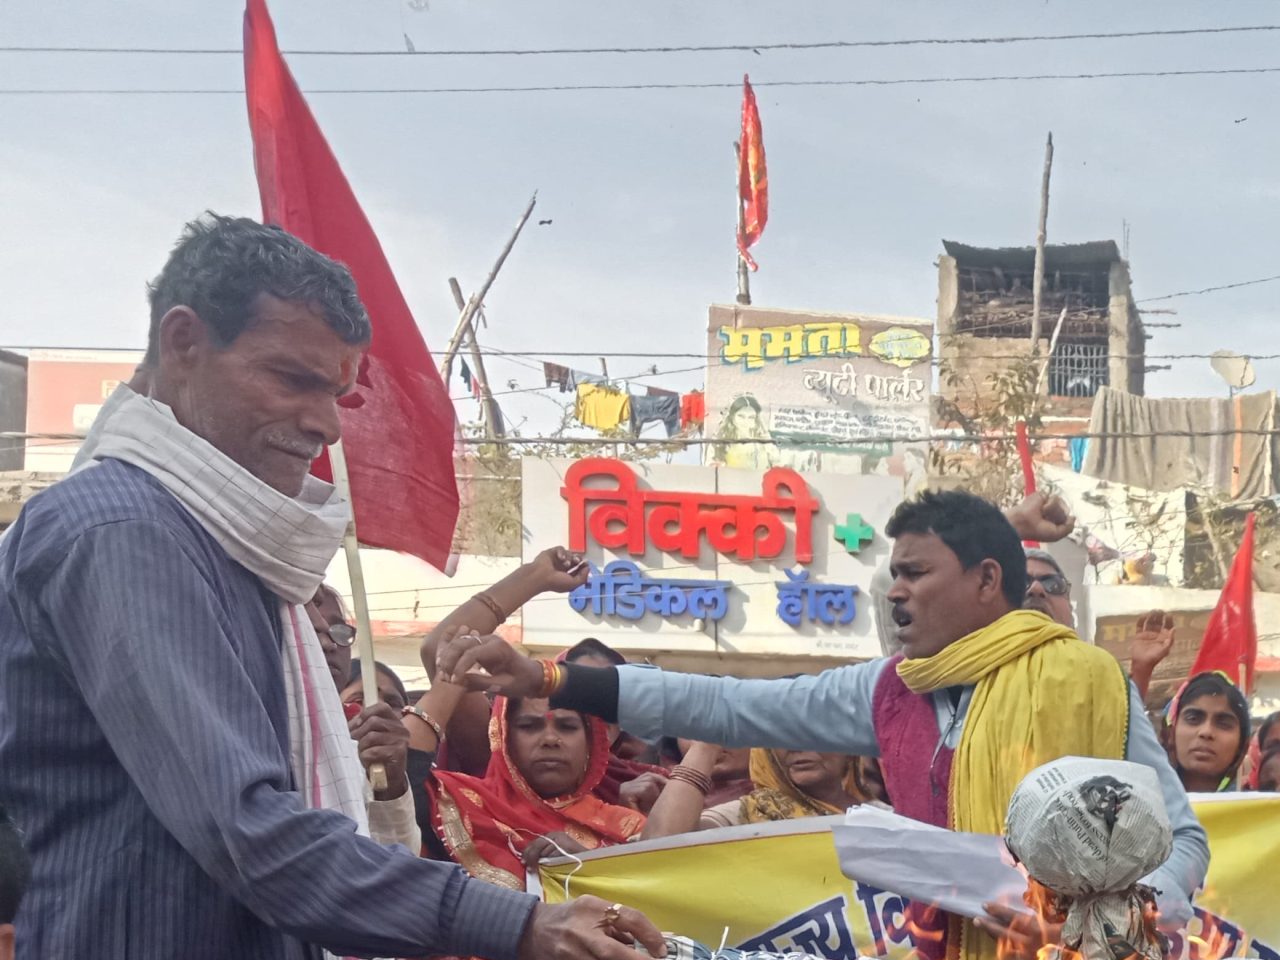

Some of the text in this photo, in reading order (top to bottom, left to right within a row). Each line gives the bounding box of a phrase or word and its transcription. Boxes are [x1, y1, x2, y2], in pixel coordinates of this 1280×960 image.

[719, 322, 862, 371] ममता
[560, 457, 819, 565] विक्की
[568, 559, 860, 626] मेडिकल हॉल
